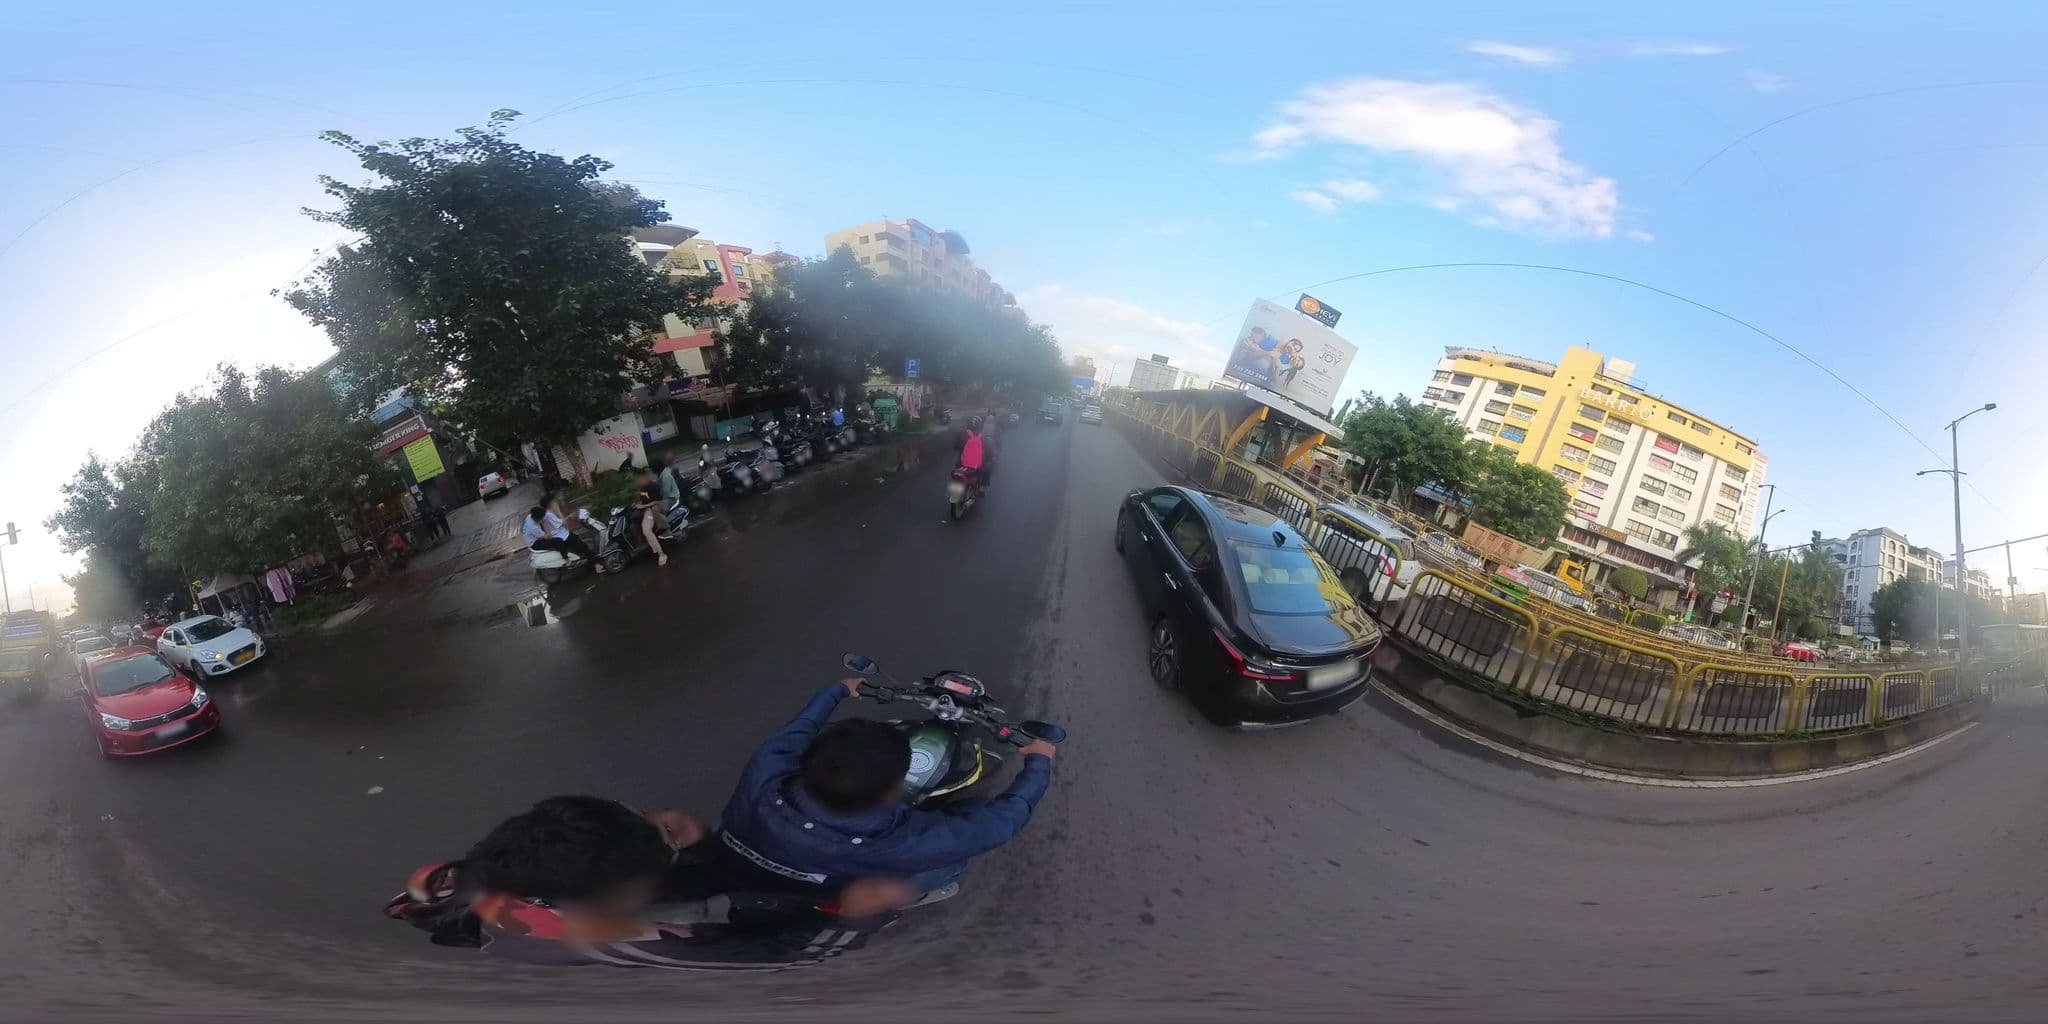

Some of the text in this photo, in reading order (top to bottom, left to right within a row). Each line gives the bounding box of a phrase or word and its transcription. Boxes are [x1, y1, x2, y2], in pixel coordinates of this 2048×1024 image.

[908, 359, 917, 370] P
[1318, 352, 1342, 366] JOY
[401, 423, 420, 437] KING
